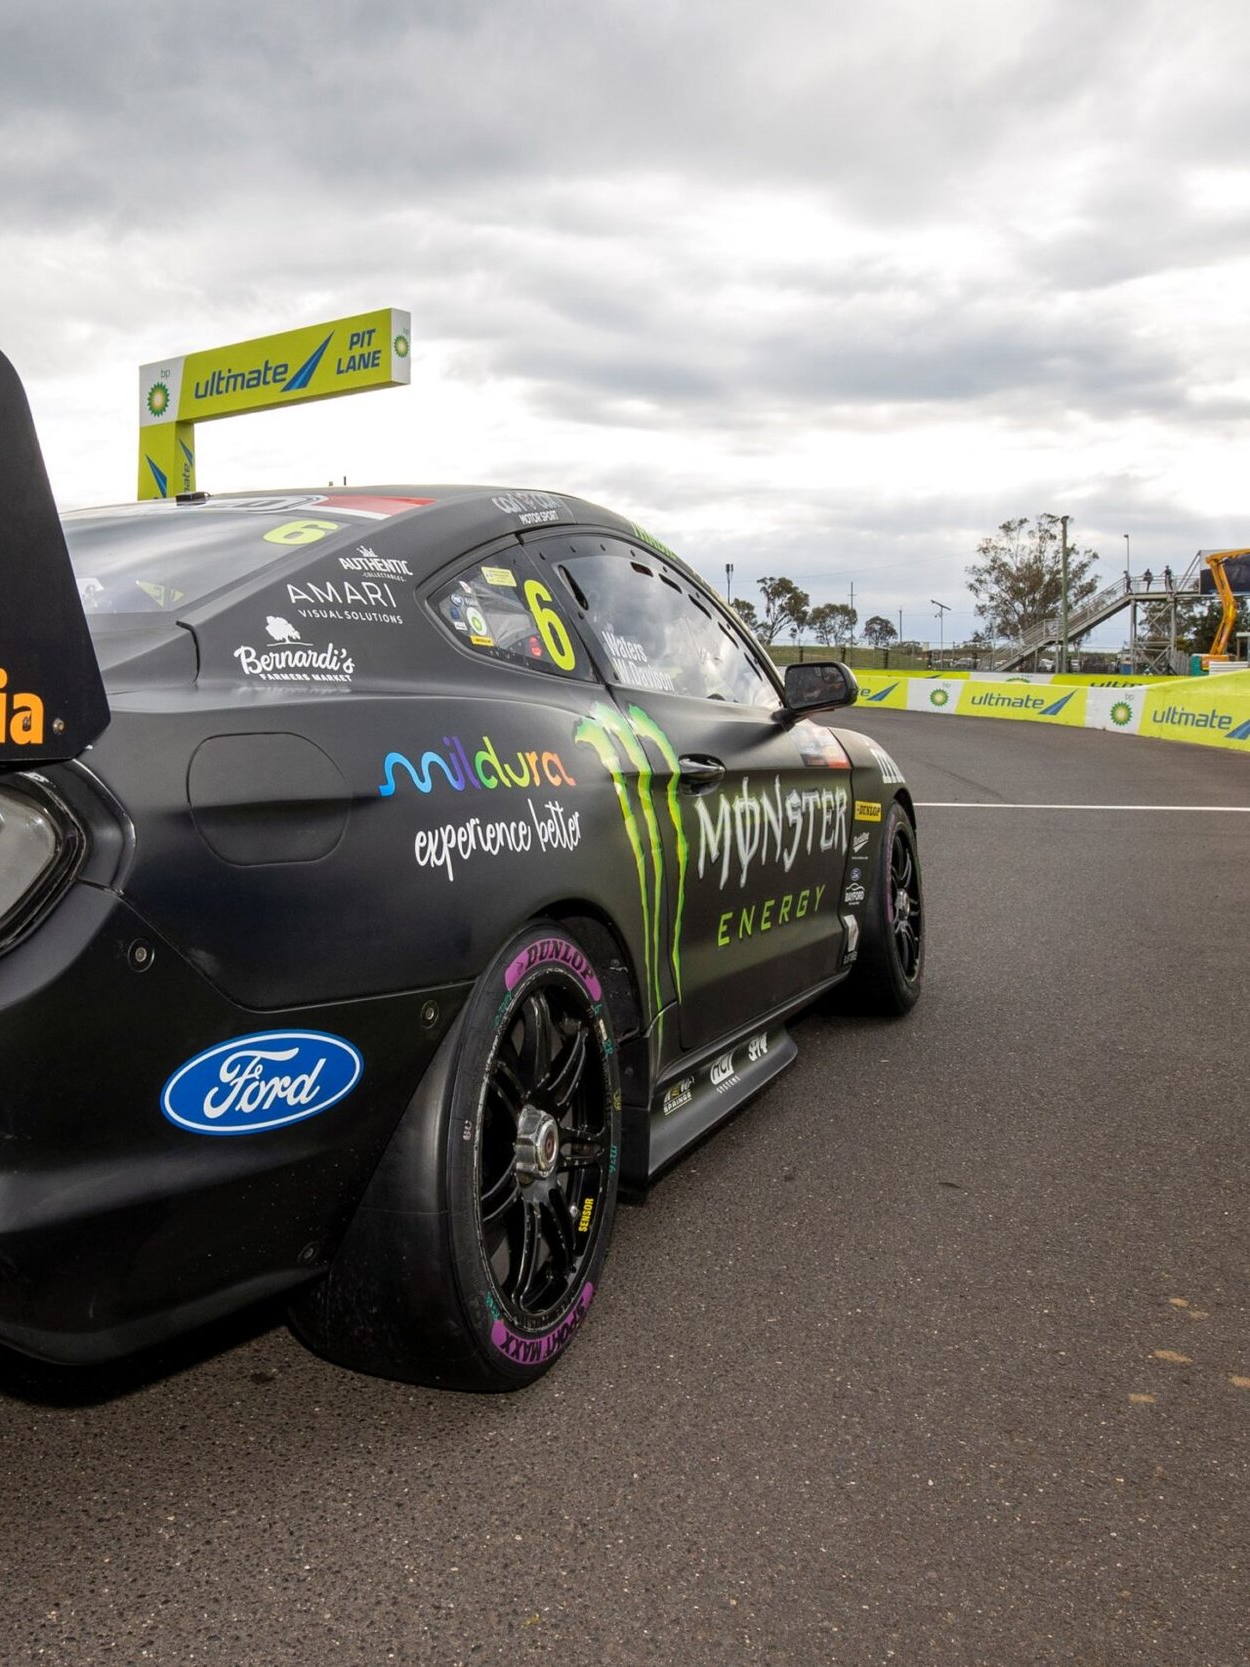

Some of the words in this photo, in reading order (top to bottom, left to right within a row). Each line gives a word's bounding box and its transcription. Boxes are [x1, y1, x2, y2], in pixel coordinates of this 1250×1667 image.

[349, 329, 376, 351] PIT
[160, 368, 171, 380] bp
[336, 350, 382, 375] LANE
[194, 359, 289, 399] ultimate
[263, 520, 339, 545] 6
[338, 557, 414, 576] AUTHENTIC
[287, 581, 397, 608] AMARI
[298, 609, 344, 620] VISUAL
[346, 610, 403, 625] SOLUTIONS
[523, 579, 576, 671] 6
[233, 642, 355, 675] Bernardi's
[259, 673, 311, 681] FARMERS
[311, 673, 352, 682] MARKET
[971, 691, 1045, 710] ultimate
[1152, 706, 1233, 730] ultimate
[378, 736, 577, 797] mildura
[415, 817, 532, 882] experience
[527, 798, 582, 853] better
[717, 884, 826, 947] ENERGY
[525, 940, 594, 980] DUNLOP
[203, 1047, 327, 1119] Ford
[663, 1091, 693, 1114] SPRINGS
[578, 1197, 595, 1233] SENSOR
